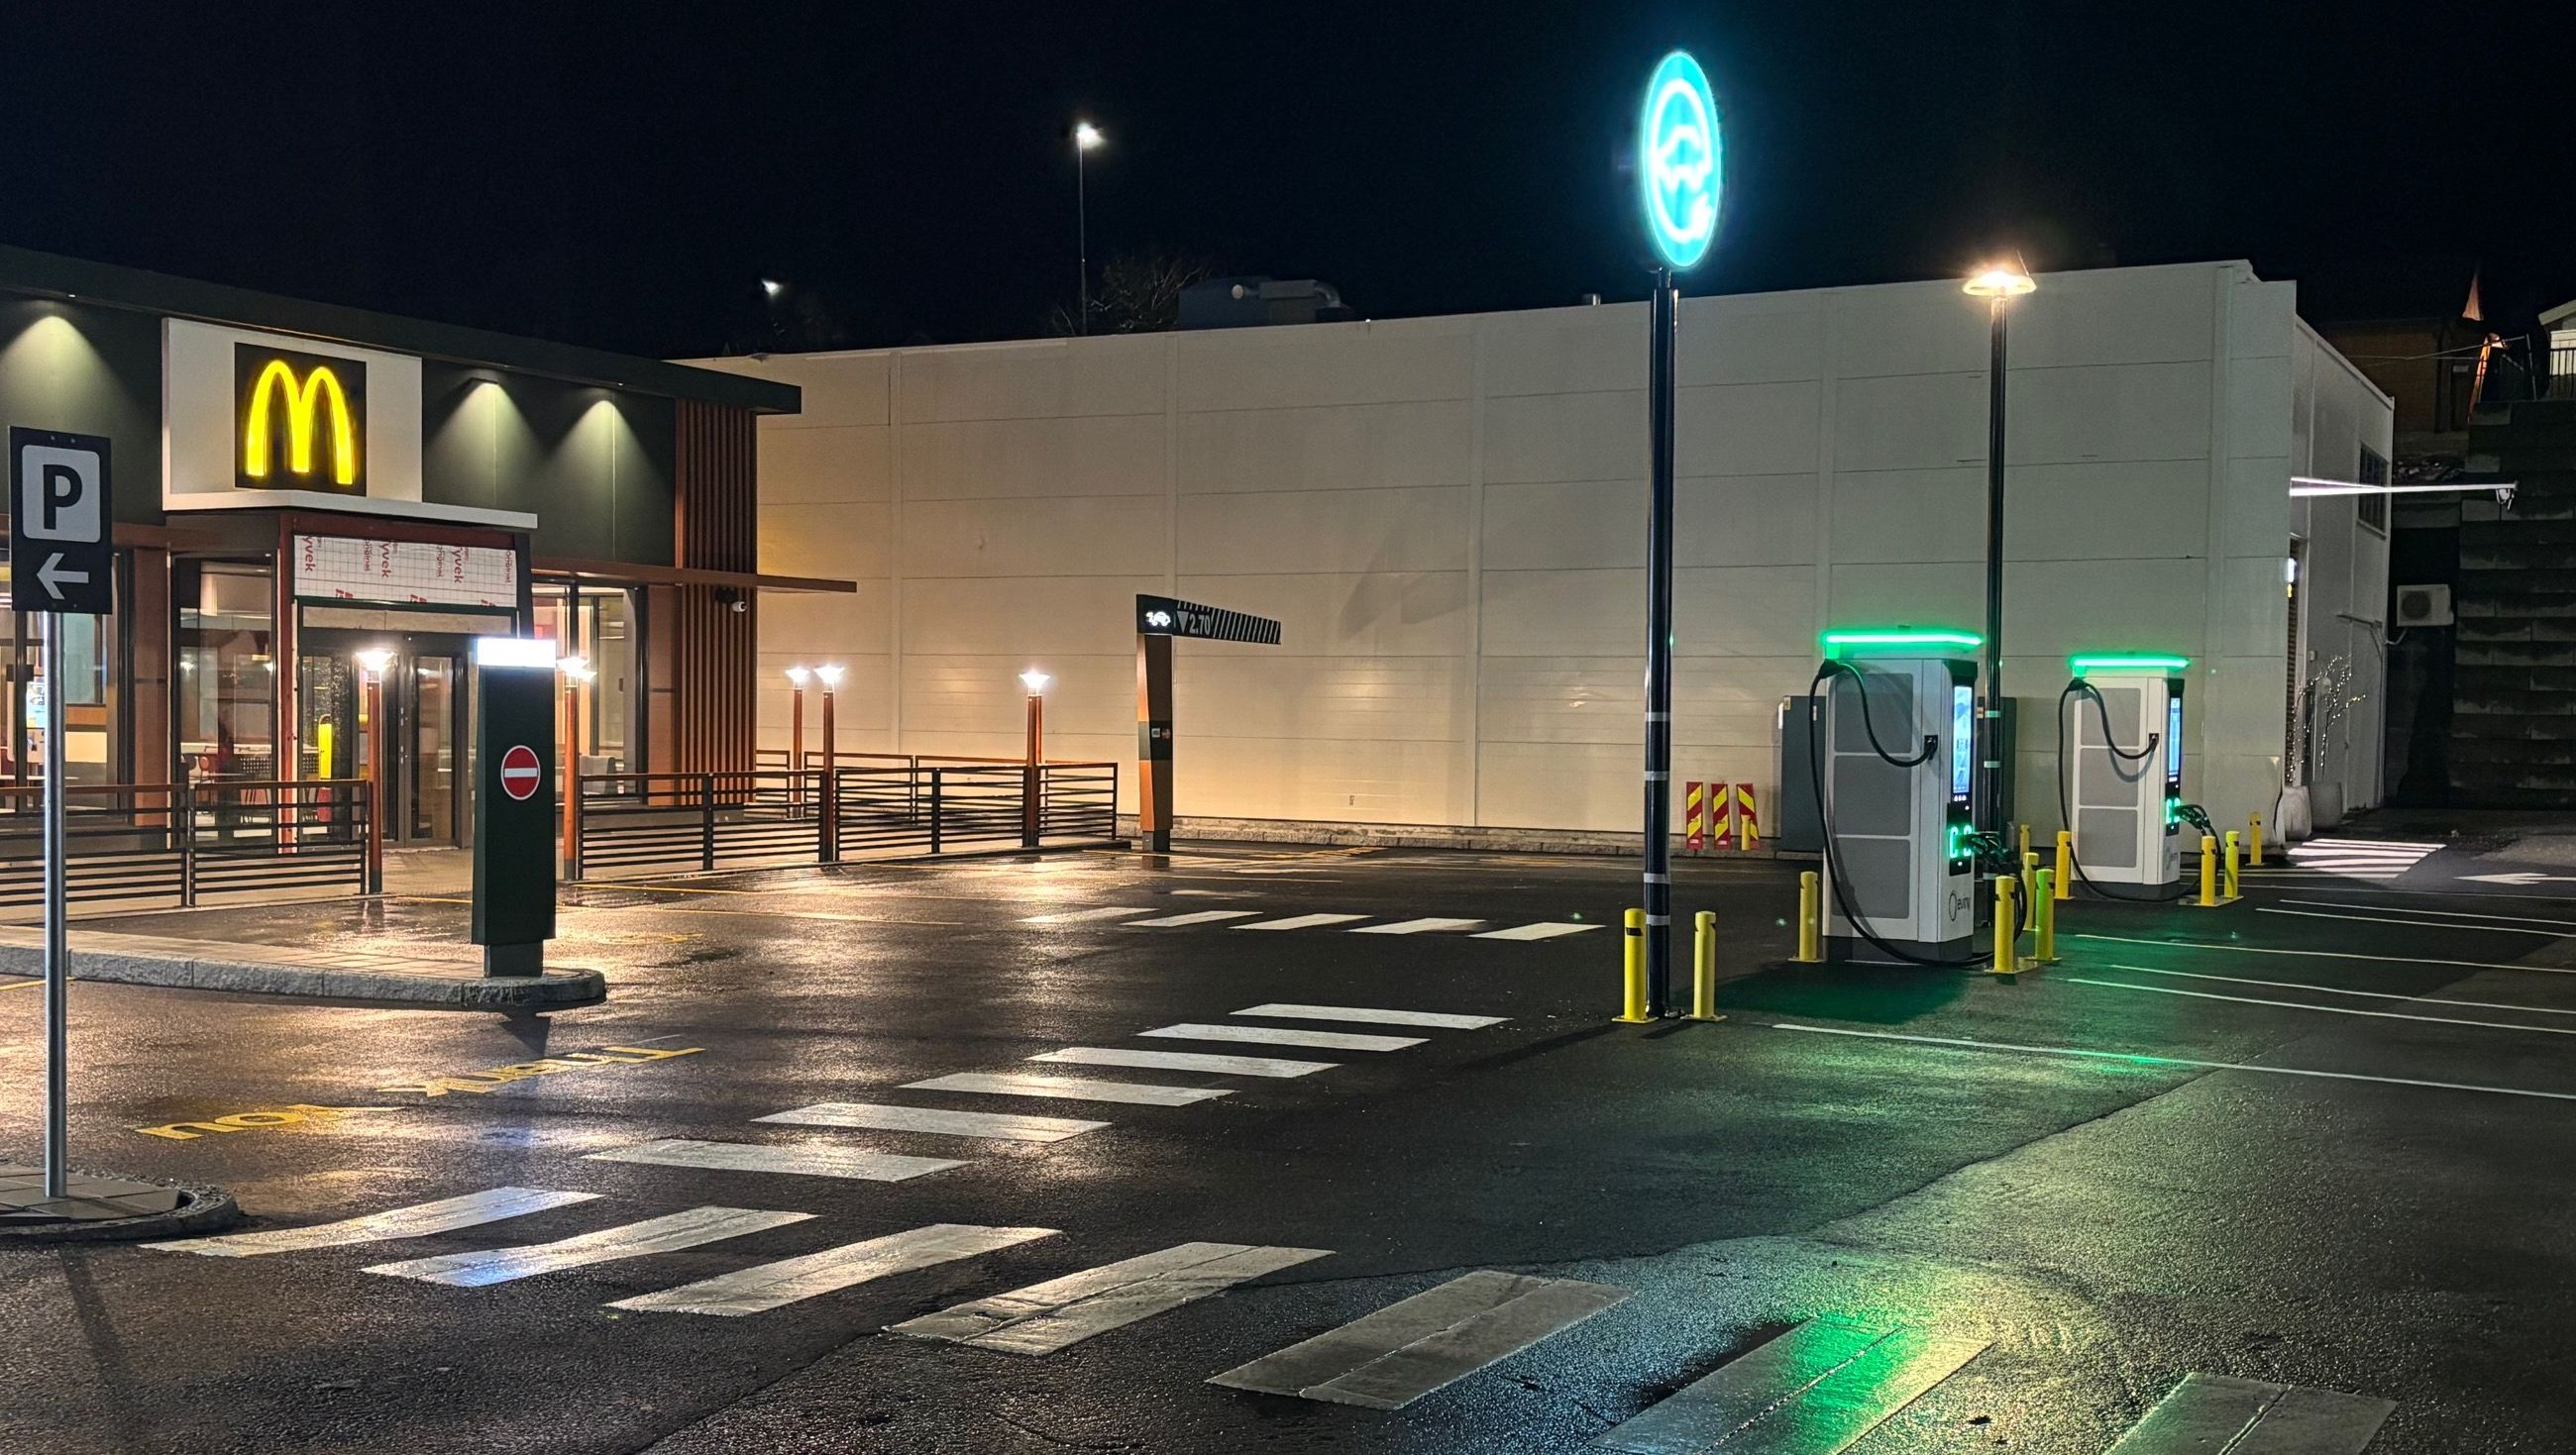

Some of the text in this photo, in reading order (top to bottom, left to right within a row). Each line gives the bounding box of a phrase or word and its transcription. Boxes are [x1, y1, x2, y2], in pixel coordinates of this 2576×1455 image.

[43, 464, 82, 531] P
[379, 542, 391, 577] yvek
[1189, 613, 1211, 635] 2.70
